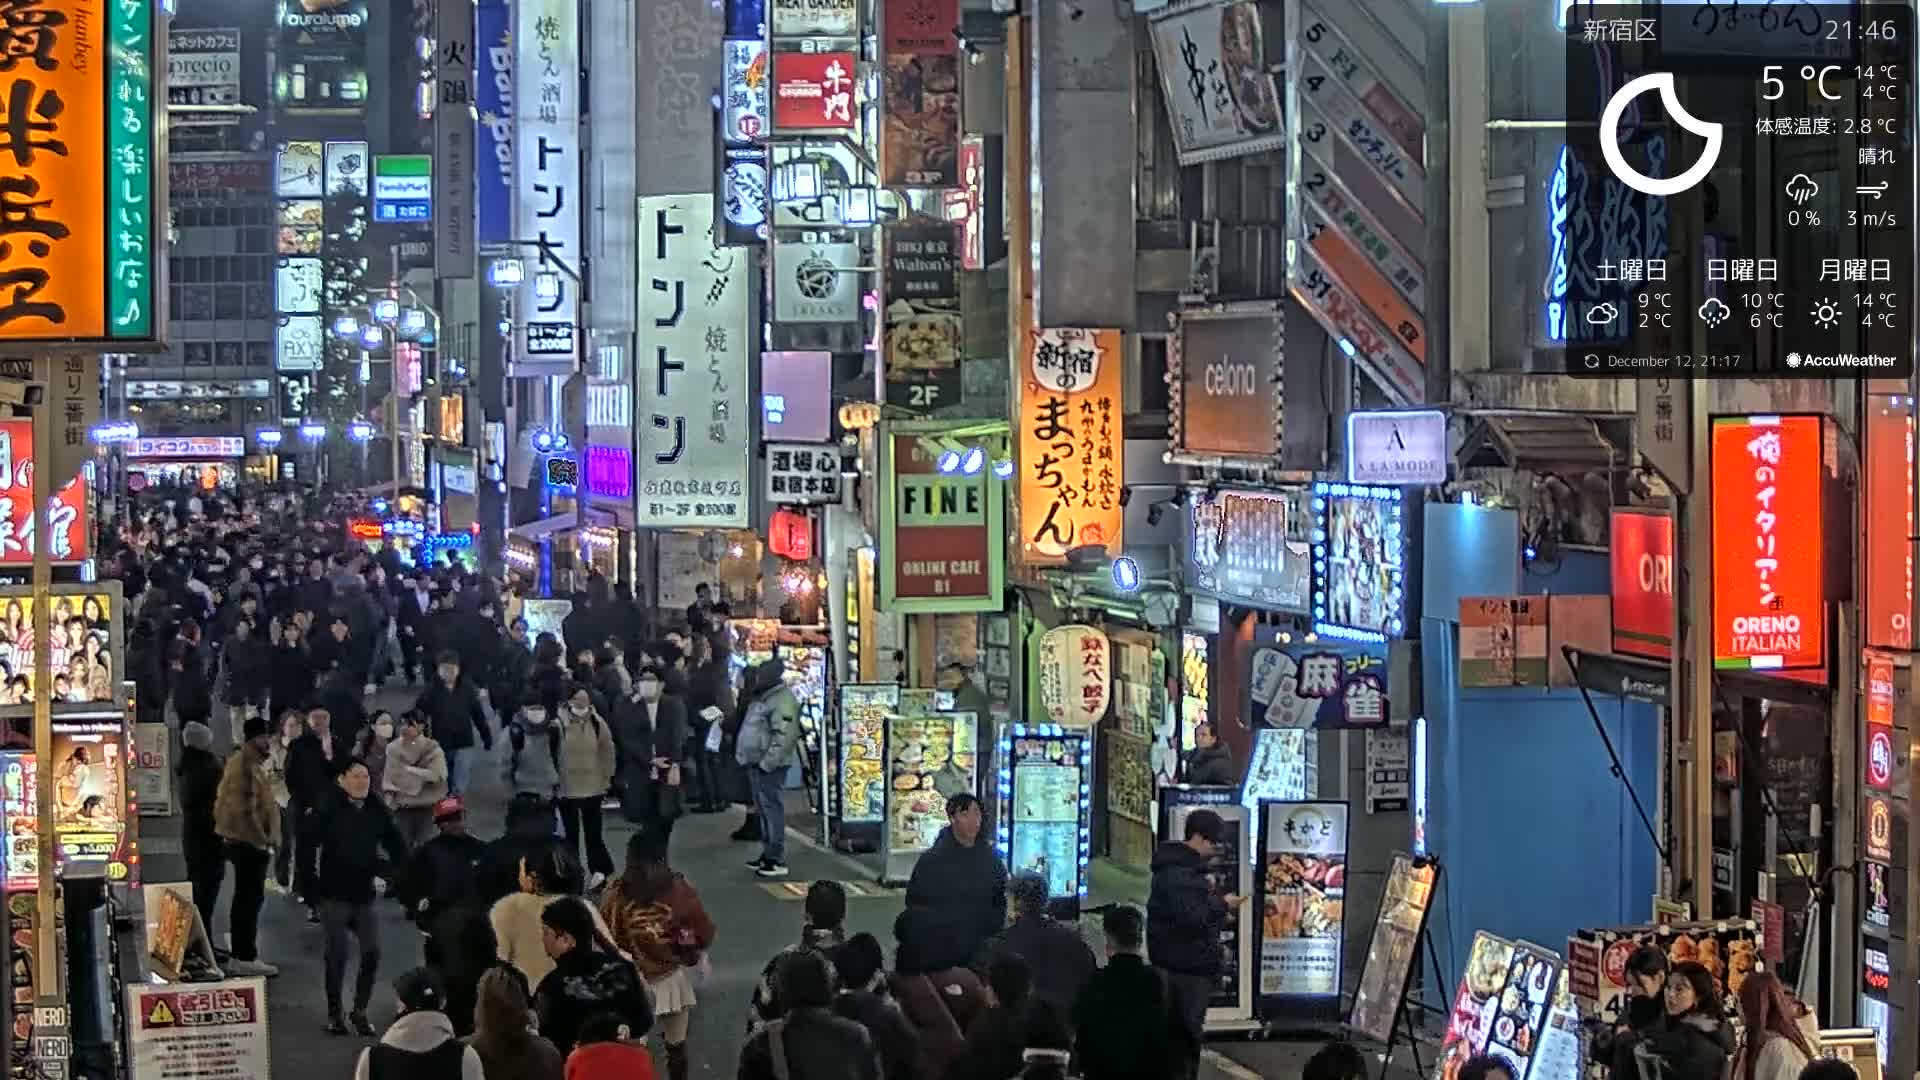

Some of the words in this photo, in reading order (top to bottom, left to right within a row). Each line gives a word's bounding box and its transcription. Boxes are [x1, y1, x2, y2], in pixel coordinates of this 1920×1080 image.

[1306, 23, 1327, 43] 5
[1307, 75, 1325, 92] 4
[1306, 123, 1326, 143] 3
[1305, 173, 1326, 191] 2
[653, 210, 685, 465] トントン
[1205, 354, 1256, 395] celona
[909, 386, 940, 405] 2F
[772, 450, 836, 473] 酒場心
[1033, 397, 1077, 545] まっちゃん
[904, 485, 980, 515] FINE
[1747, 430, 1781, 604] 俺のイタリアン
[951, 560, 981, 575] CAFE
[1732, 615, 1801, 635] ORENO
[1732, 635, 1801, 653] ITALIAN
[34, 1008, 65, 1026] NERO
[37, 1038, 67, 1057] NERO
